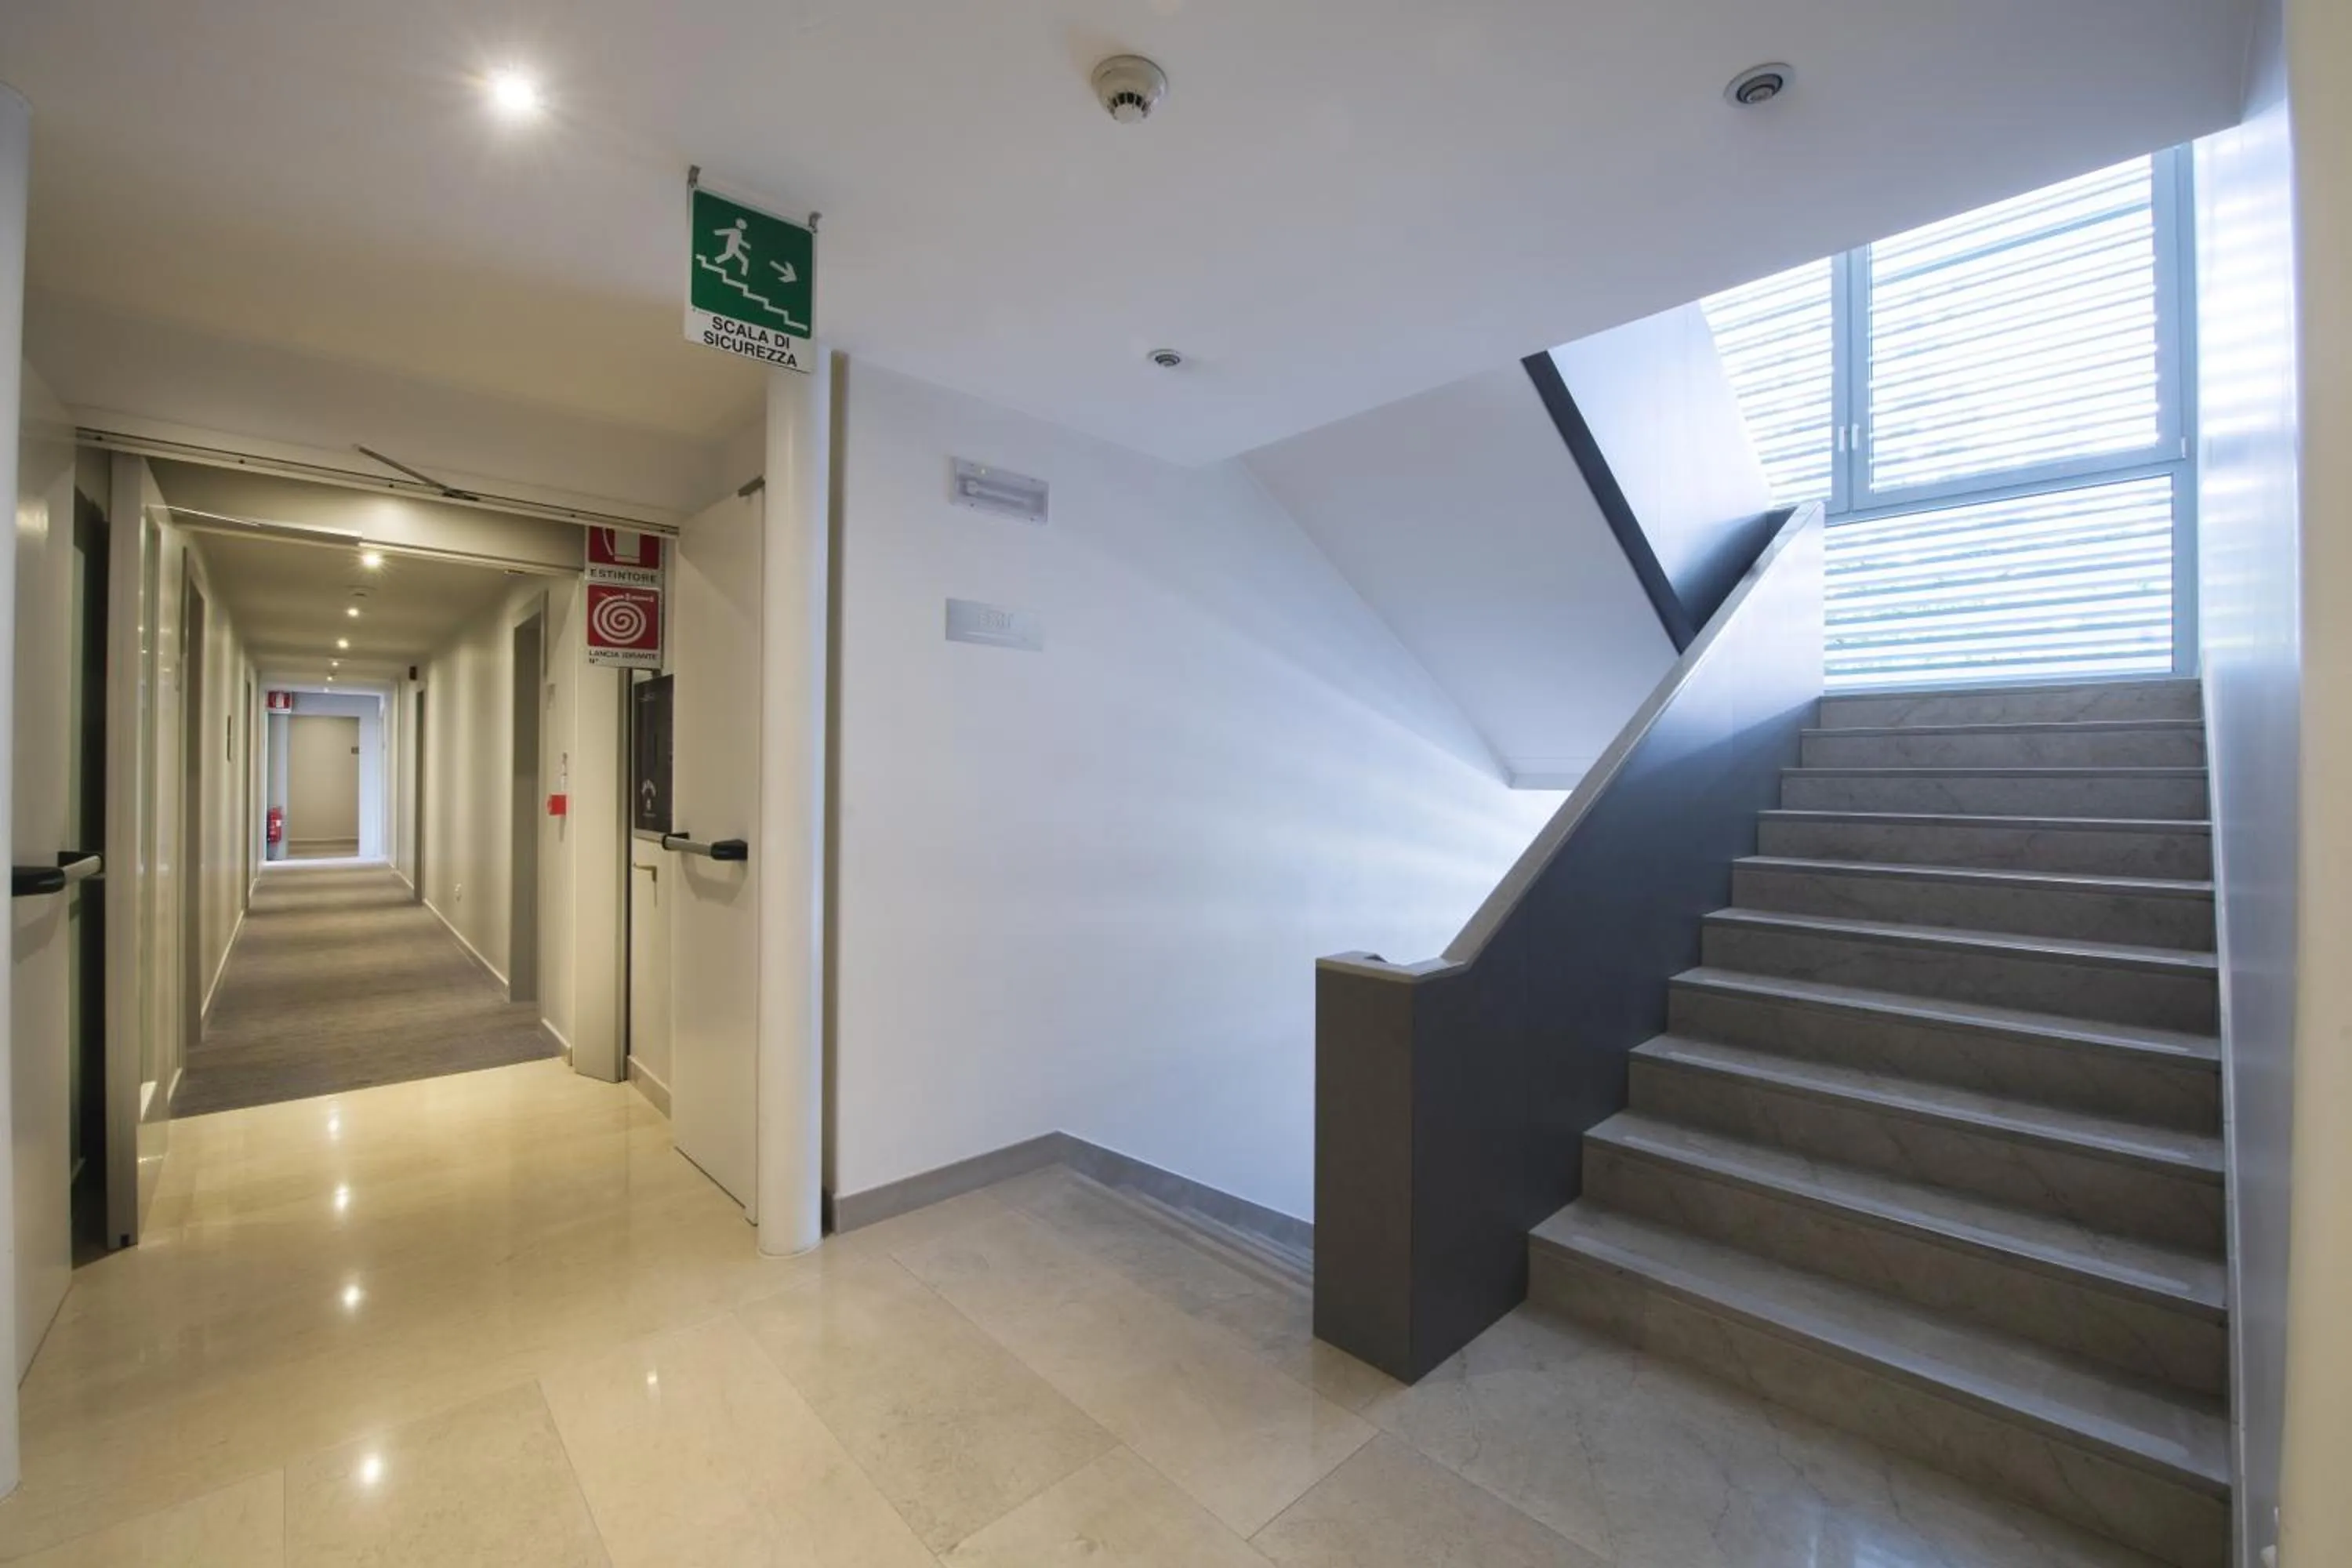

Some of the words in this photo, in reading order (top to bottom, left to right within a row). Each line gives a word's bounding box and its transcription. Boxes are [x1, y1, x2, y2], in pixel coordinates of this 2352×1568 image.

[712, 316, 768, 343] SCALA
[774, 335, 789, 349] DI
[703, 331, 797, 368] SICUREZZA
[590, 568, 656, 583] ESTINTORE
[589, 649, 619, 659] LANCIA
